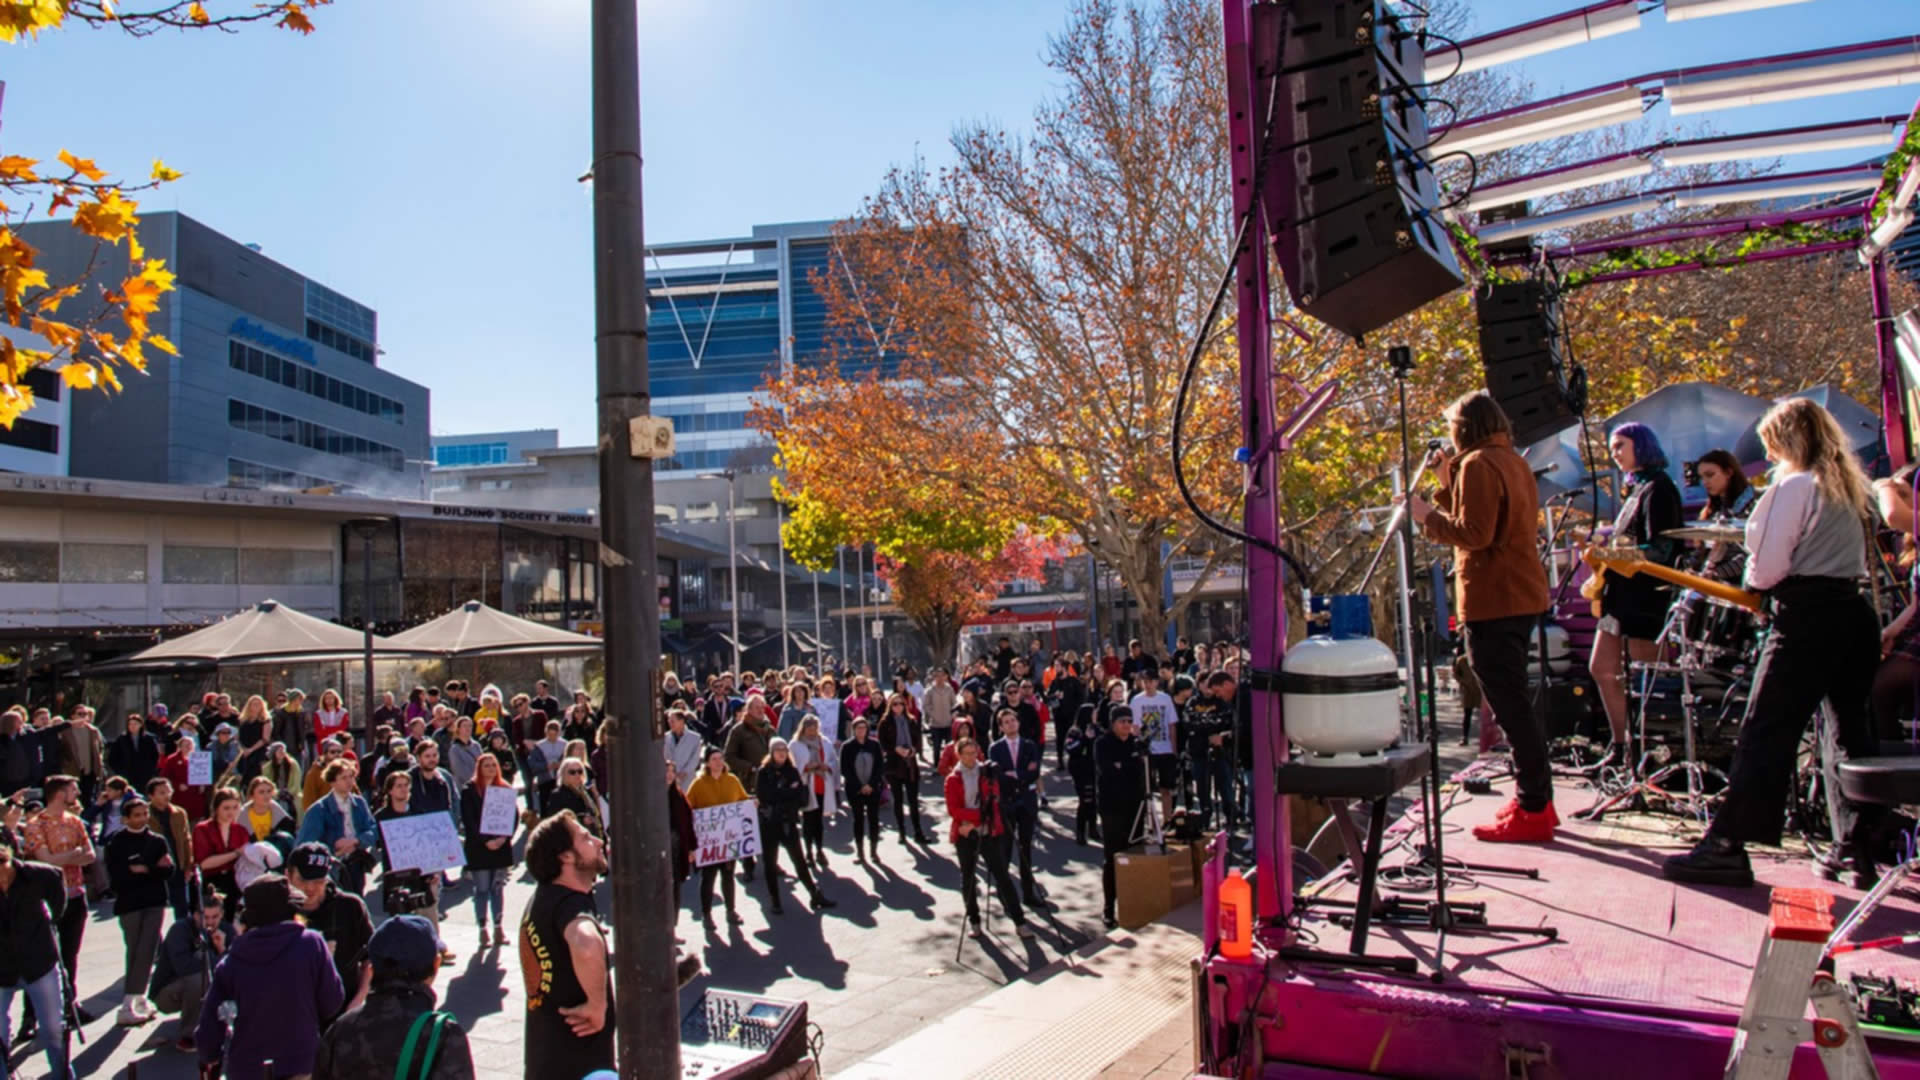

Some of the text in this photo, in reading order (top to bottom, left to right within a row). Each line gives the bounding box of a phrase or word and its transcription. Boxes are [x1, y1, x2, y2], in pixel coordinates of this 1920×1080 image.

[433, 506, 594, 524] BUILDING SOCIETY HOUSE
[701, 837, 755, 862] MUSIC
